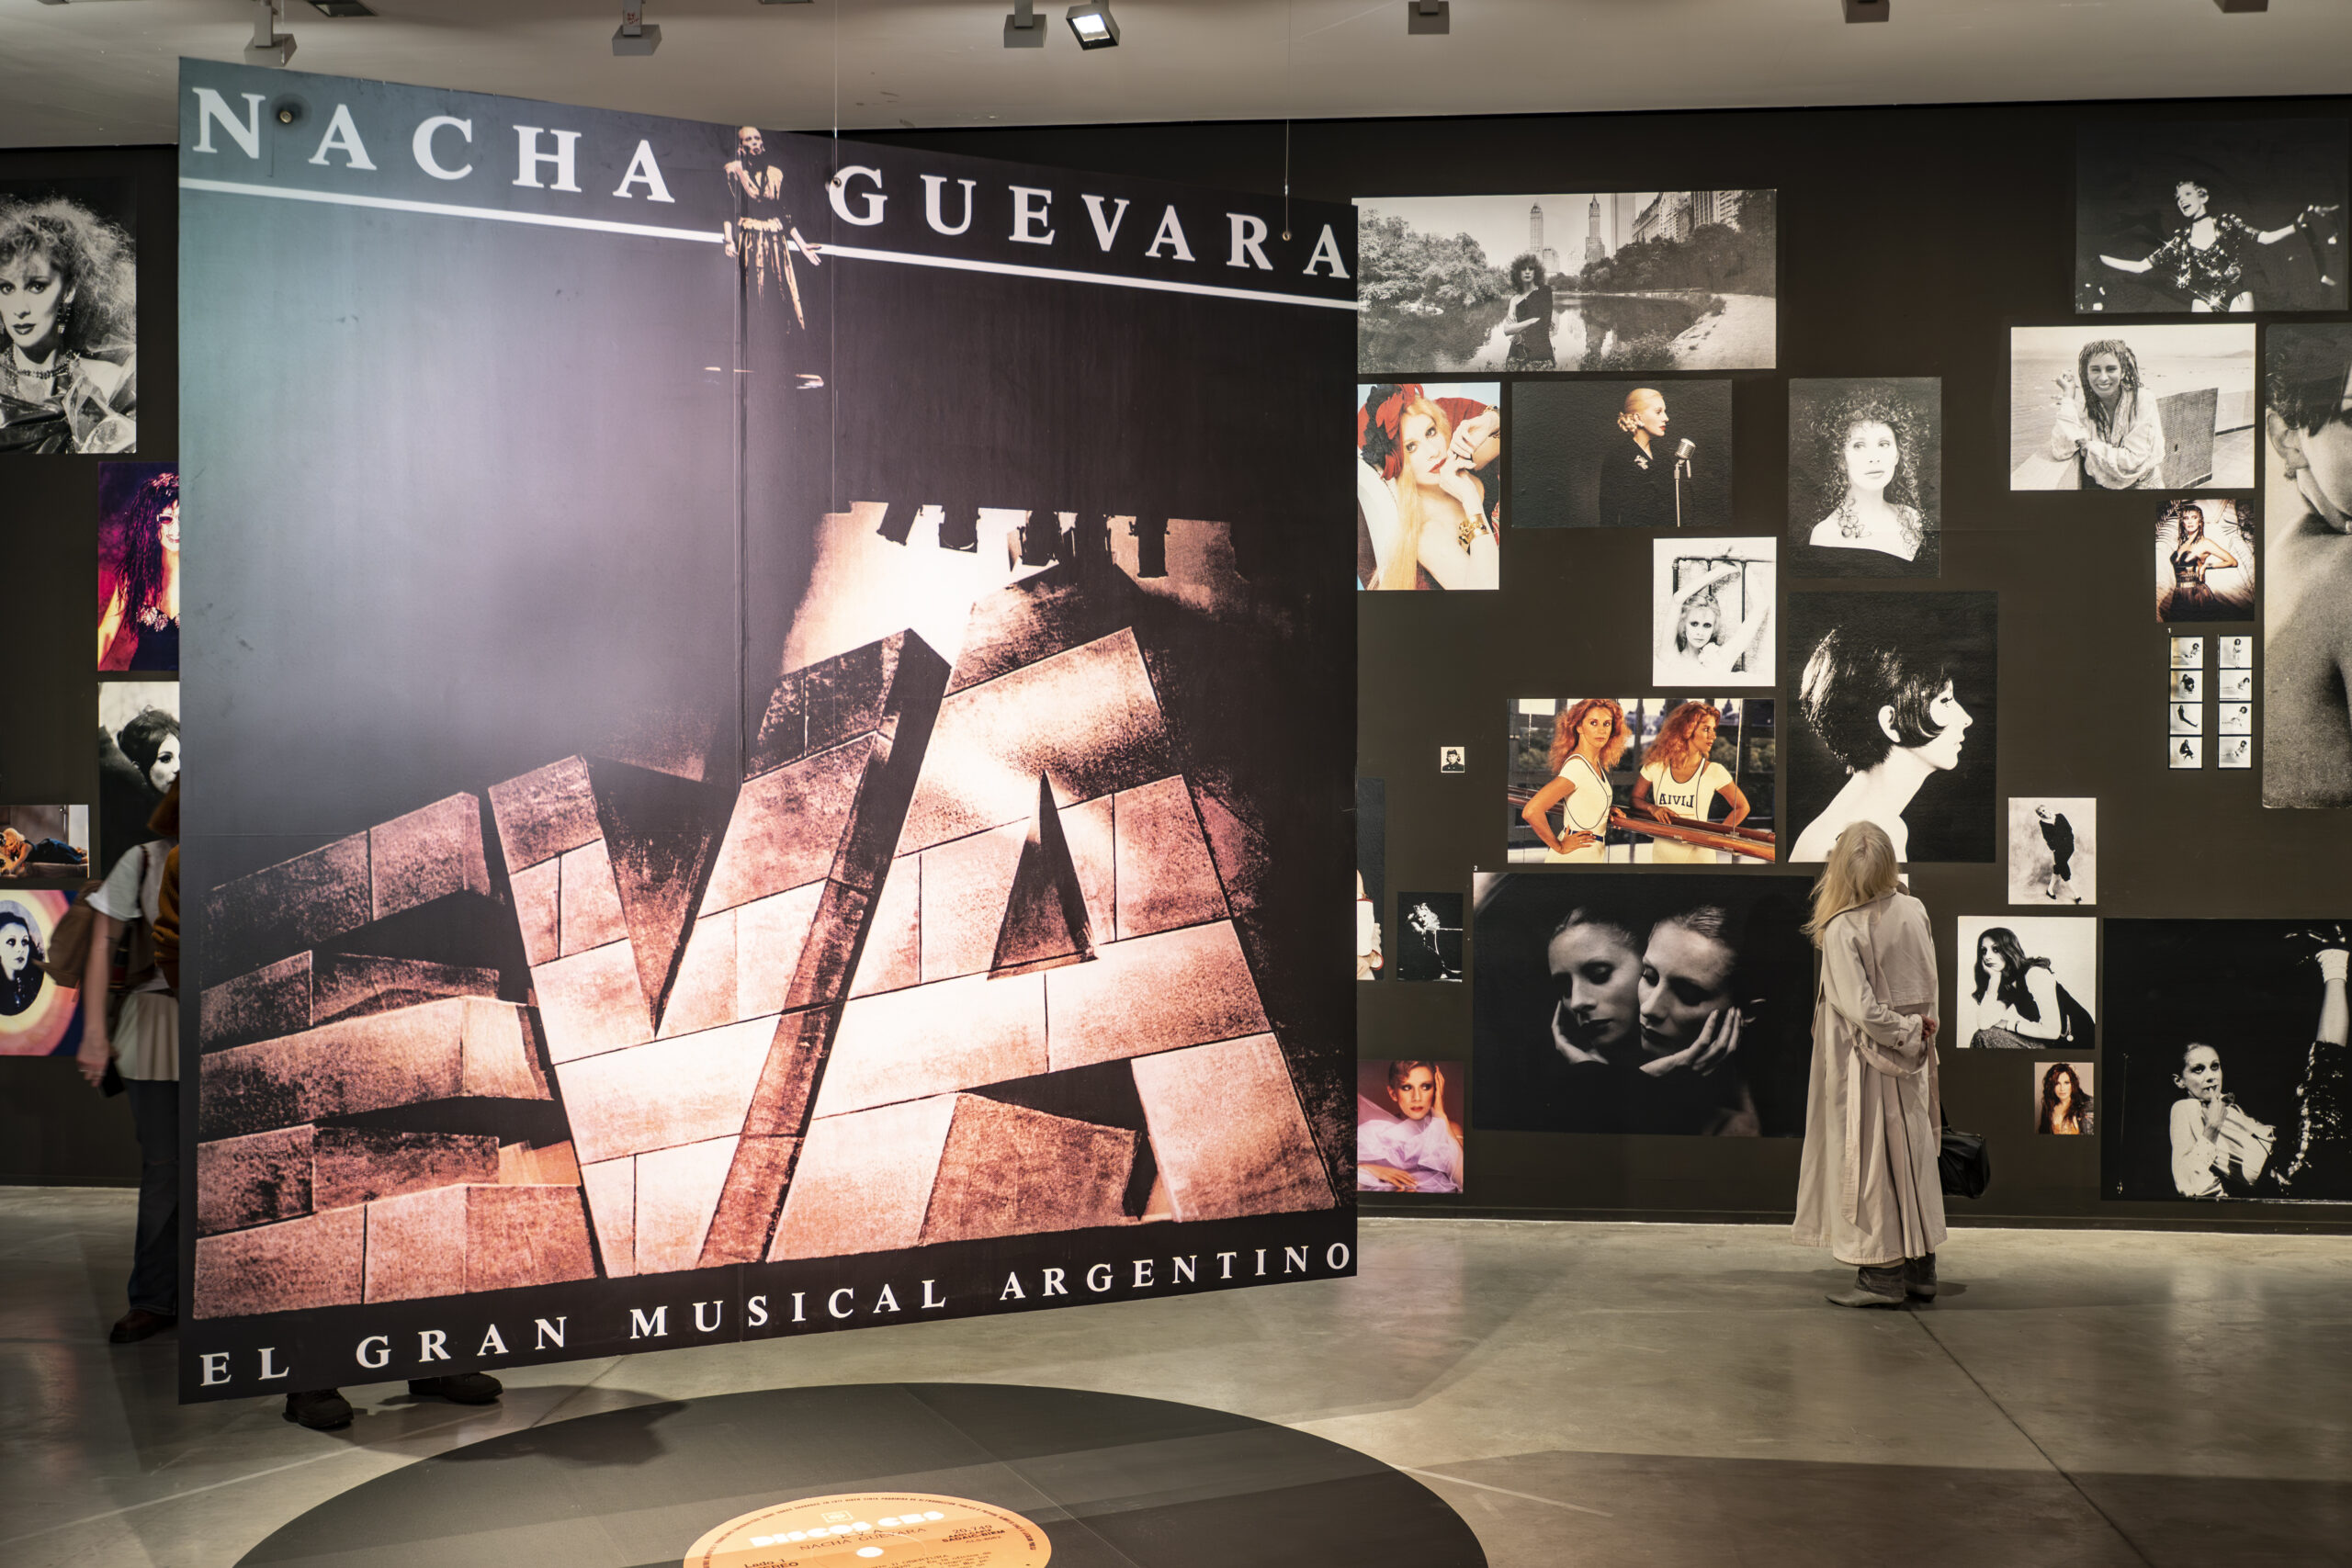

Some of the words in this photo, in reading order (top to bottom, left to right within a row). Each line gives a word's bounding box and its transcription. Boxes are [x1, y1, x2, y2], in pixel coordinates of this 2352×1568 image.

[192, 87, 675, 204] NACHA
[828, 165, 1351, 279] GUEVARA
[199, 1348, 290, 1387] EL
[356, 1315, 568, 1370] GRAN
[629, 1279, 946, 1341] MUSICAL
[1000, 1242, 1351, 1302] ARGENTINO
[749, 1520, 873, 1548] DISCOS
[877, 1510, 944, 1528] CBS
[798, 1539, 853, 1551] NACHA
